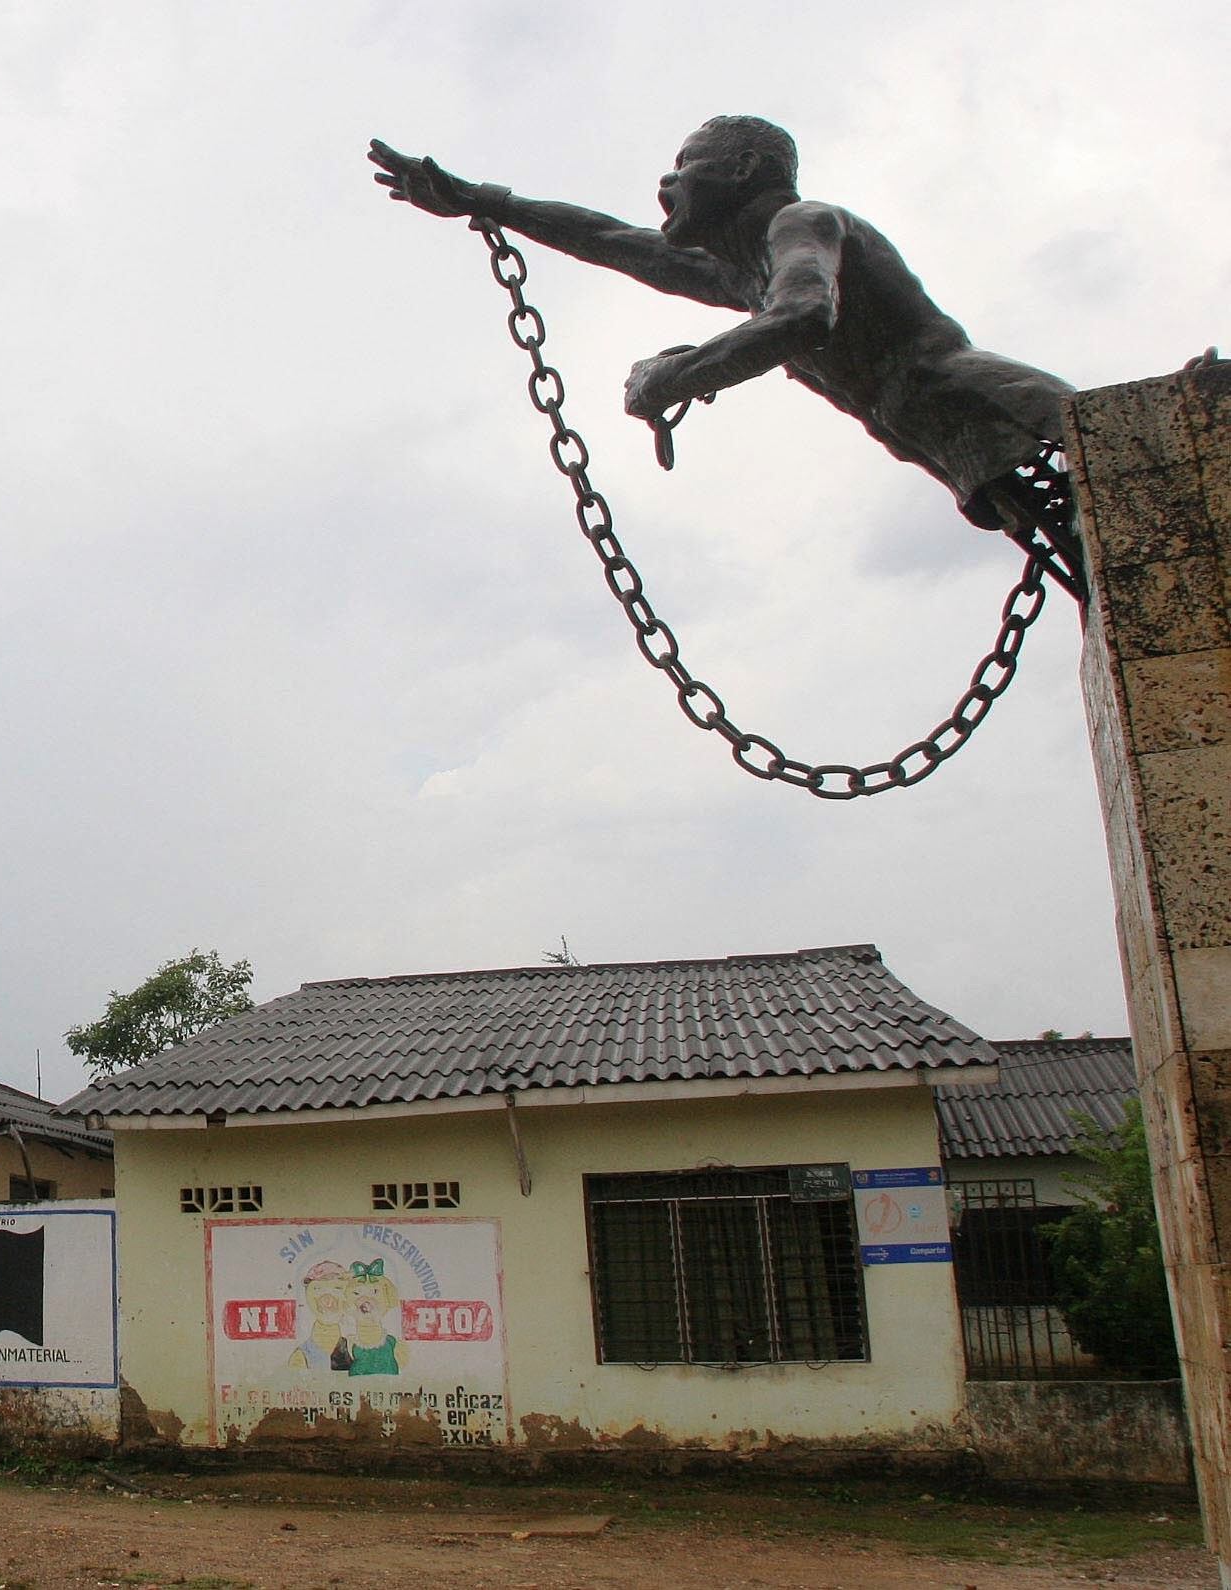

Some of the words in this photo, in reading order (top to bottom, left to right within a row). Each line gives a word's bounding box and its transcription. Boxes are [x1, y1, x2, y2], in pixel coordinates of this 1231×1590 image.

[279, 1228, 315, 1262] SIN
[362, 1223, 441, 1299] PRESERVATIVOS
[238, 1307, 278, 1333] NI
[417, 1307, 488, 1334] PIO!
[329, 1391, 353, 1407] es
[445, 1385, 502, 1410] eficaz
